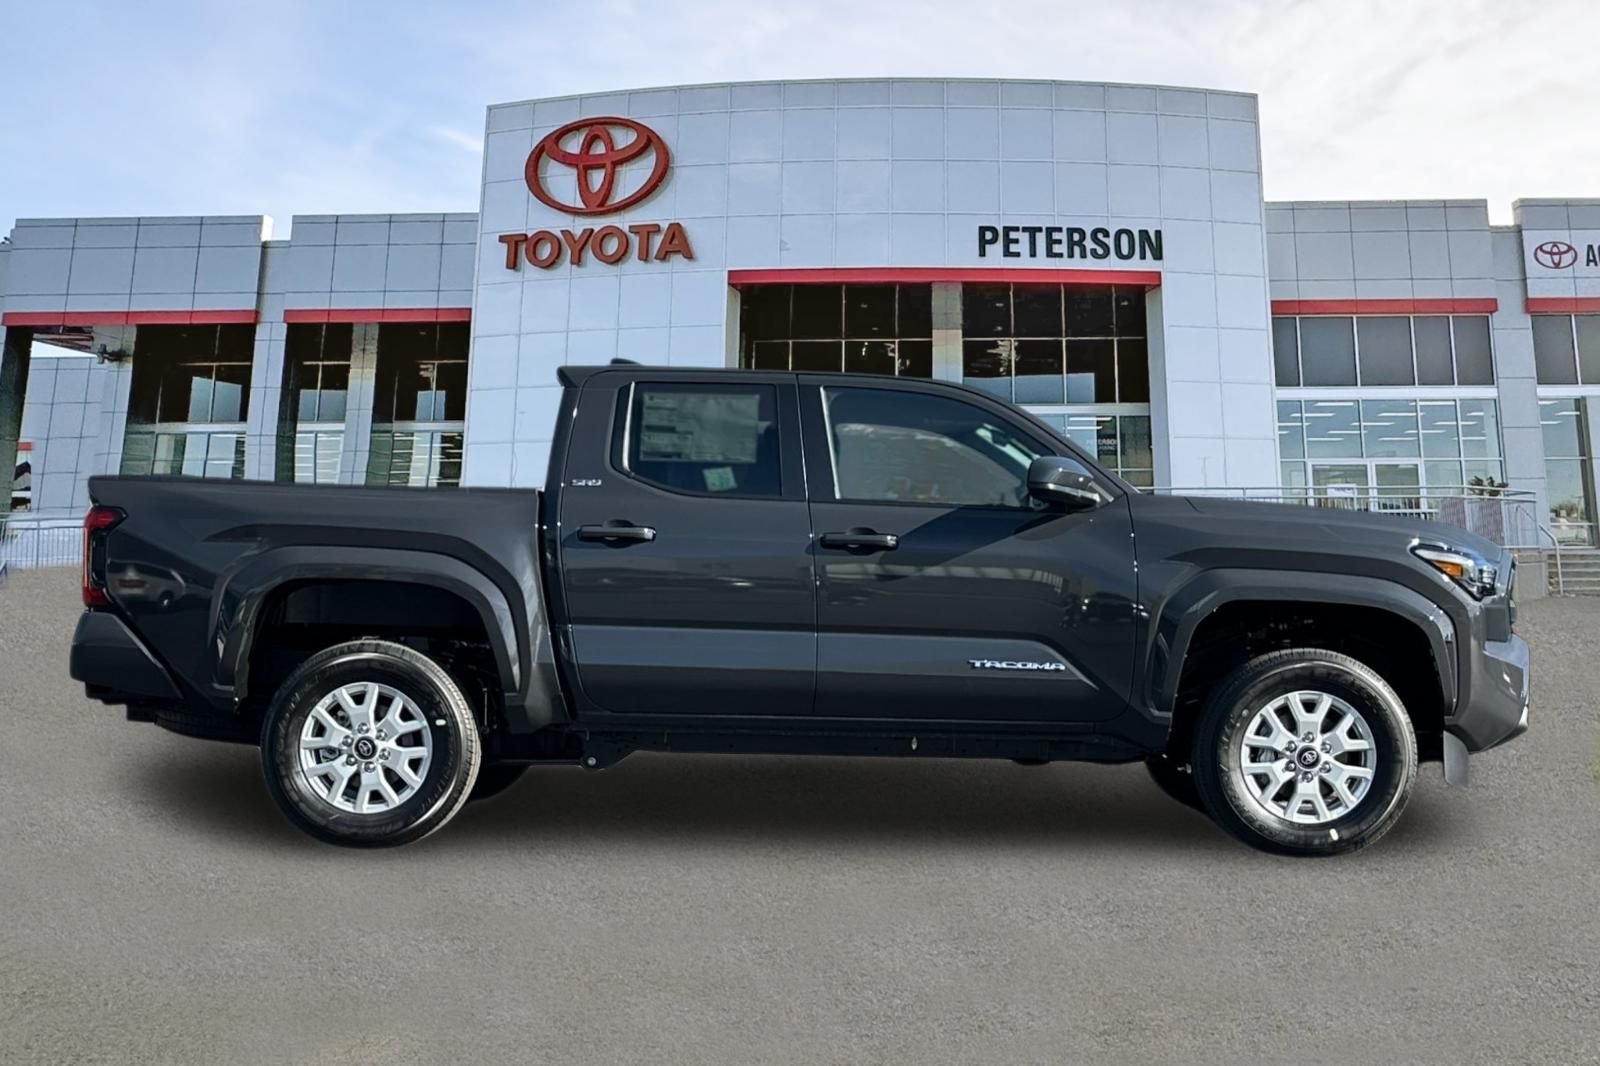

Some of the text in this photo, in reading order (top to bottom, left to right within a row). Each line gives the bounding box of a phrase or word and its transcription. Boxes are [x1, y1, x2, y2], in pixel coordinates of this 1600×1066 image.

[498, 222, 694, 270] TOYOTA
[978, 225, 1164, 261] PETERSON
[1586, 243, 1600, 267] A
[968, 659, 1066, 671] TACOMA
